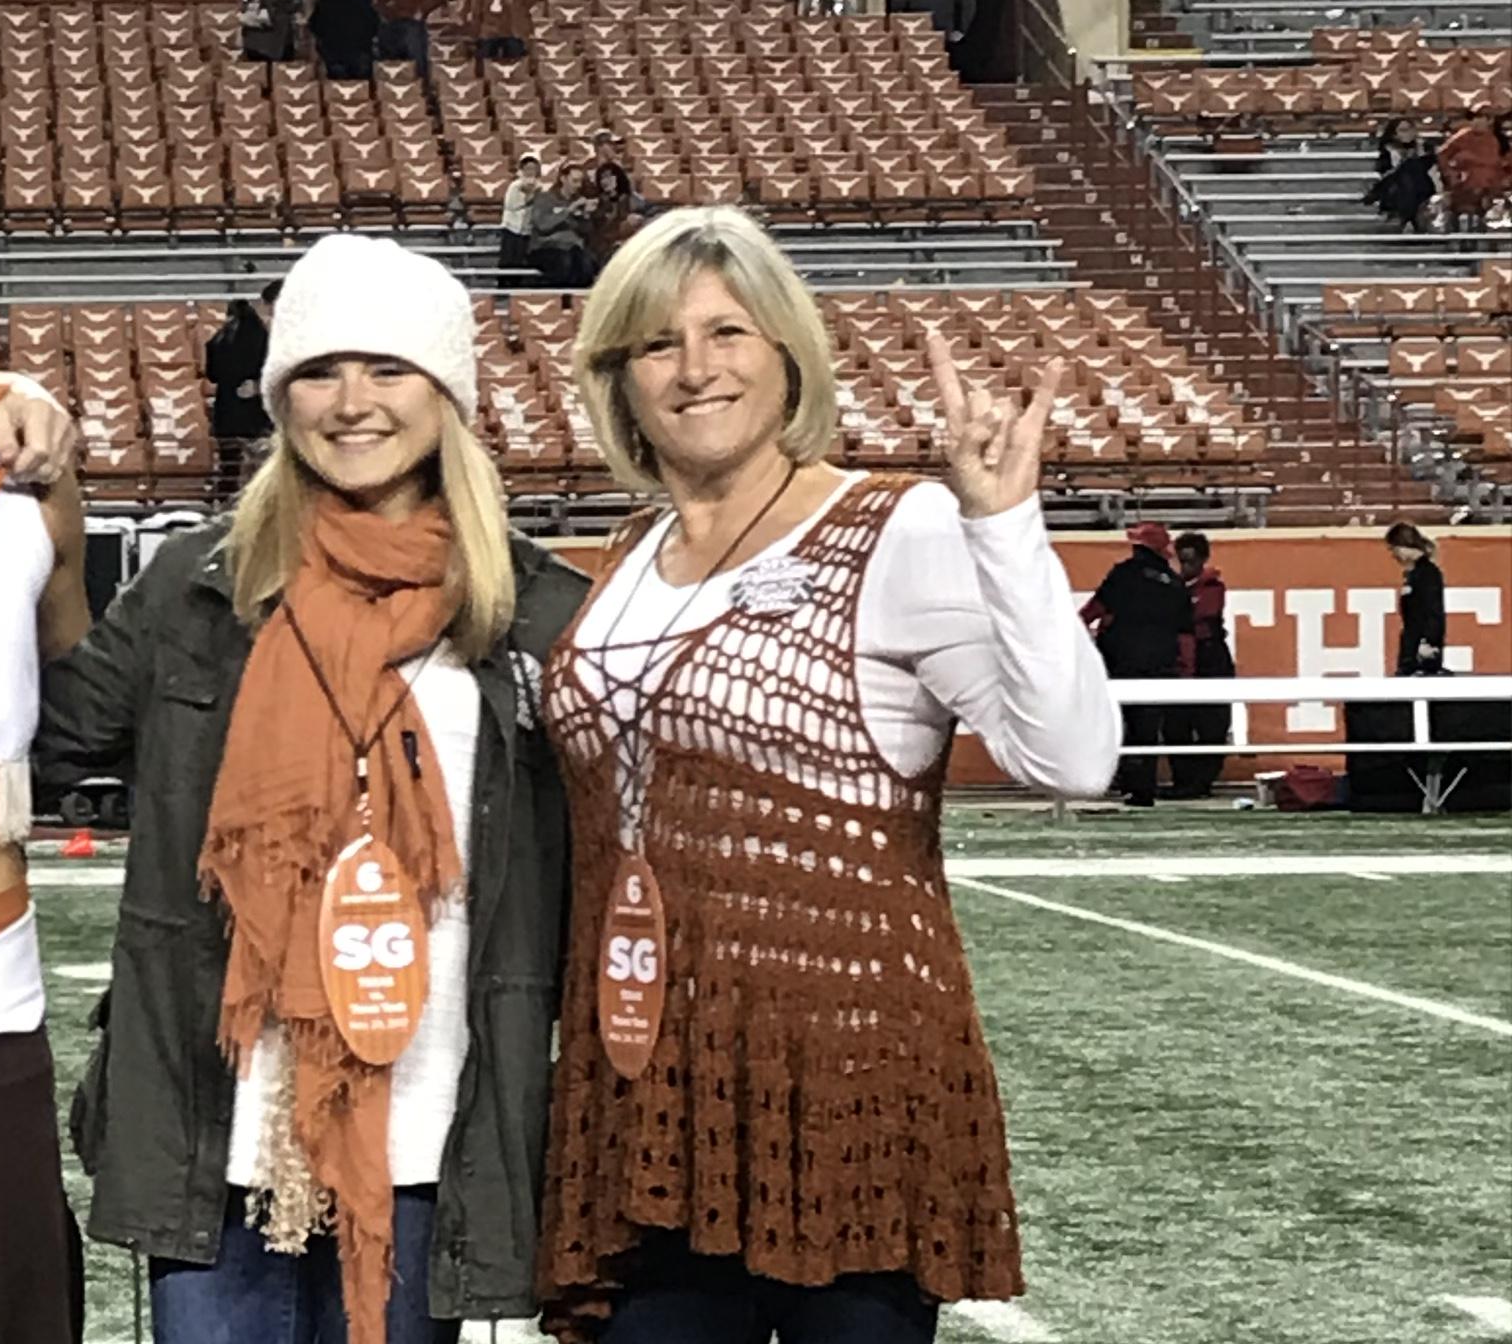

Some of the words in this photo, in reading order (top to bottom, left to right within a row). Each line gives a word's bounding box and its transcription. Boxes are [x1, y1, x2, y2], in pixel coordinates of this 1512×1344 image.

[356, 861, 383, 892] 6
[626, 875, 642, 904] 6
[332, 922, 415, 970] SG
[606, 936, 657, 983] SG
